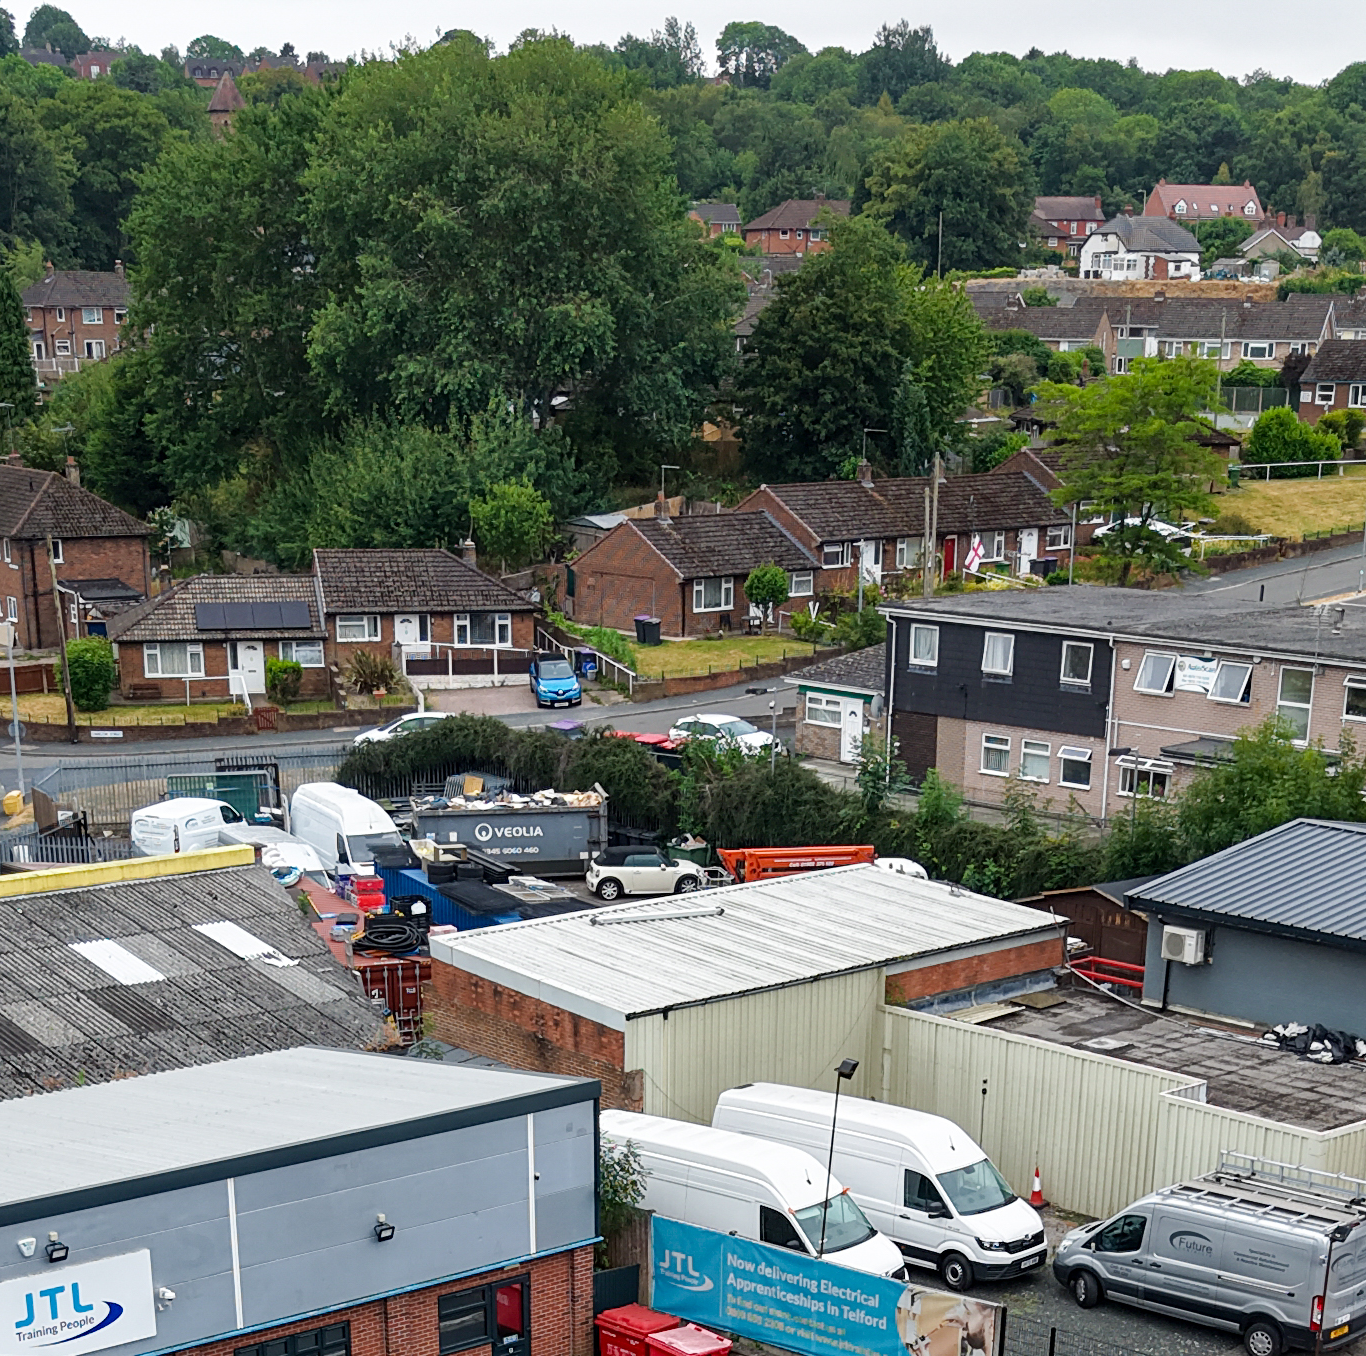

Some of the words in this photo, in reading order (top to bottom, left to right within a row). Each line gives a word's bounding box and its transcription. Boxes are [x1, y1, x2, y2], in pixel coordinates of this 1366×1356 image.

[494, 826, 544, 838] VEOLIA
[1178, 1237, 1213, 1255] Future
[659, 1249, 700, 1277] JTL
[727, 1252, 756, 1273] Now
[757, 1262, 818, 1294] delivering
[820, 1279, 879, 1308] Electrical
[15, 1282, 94, 1329] JTL
[727, 1272, 824, 1312] Apprenticeships
[827, 1300, 840, 1317] in
[841, 1305, 887, 1330] Telford
[16, 1324, 59, 1342] Training
[60, 1315, 95, 1332] People
